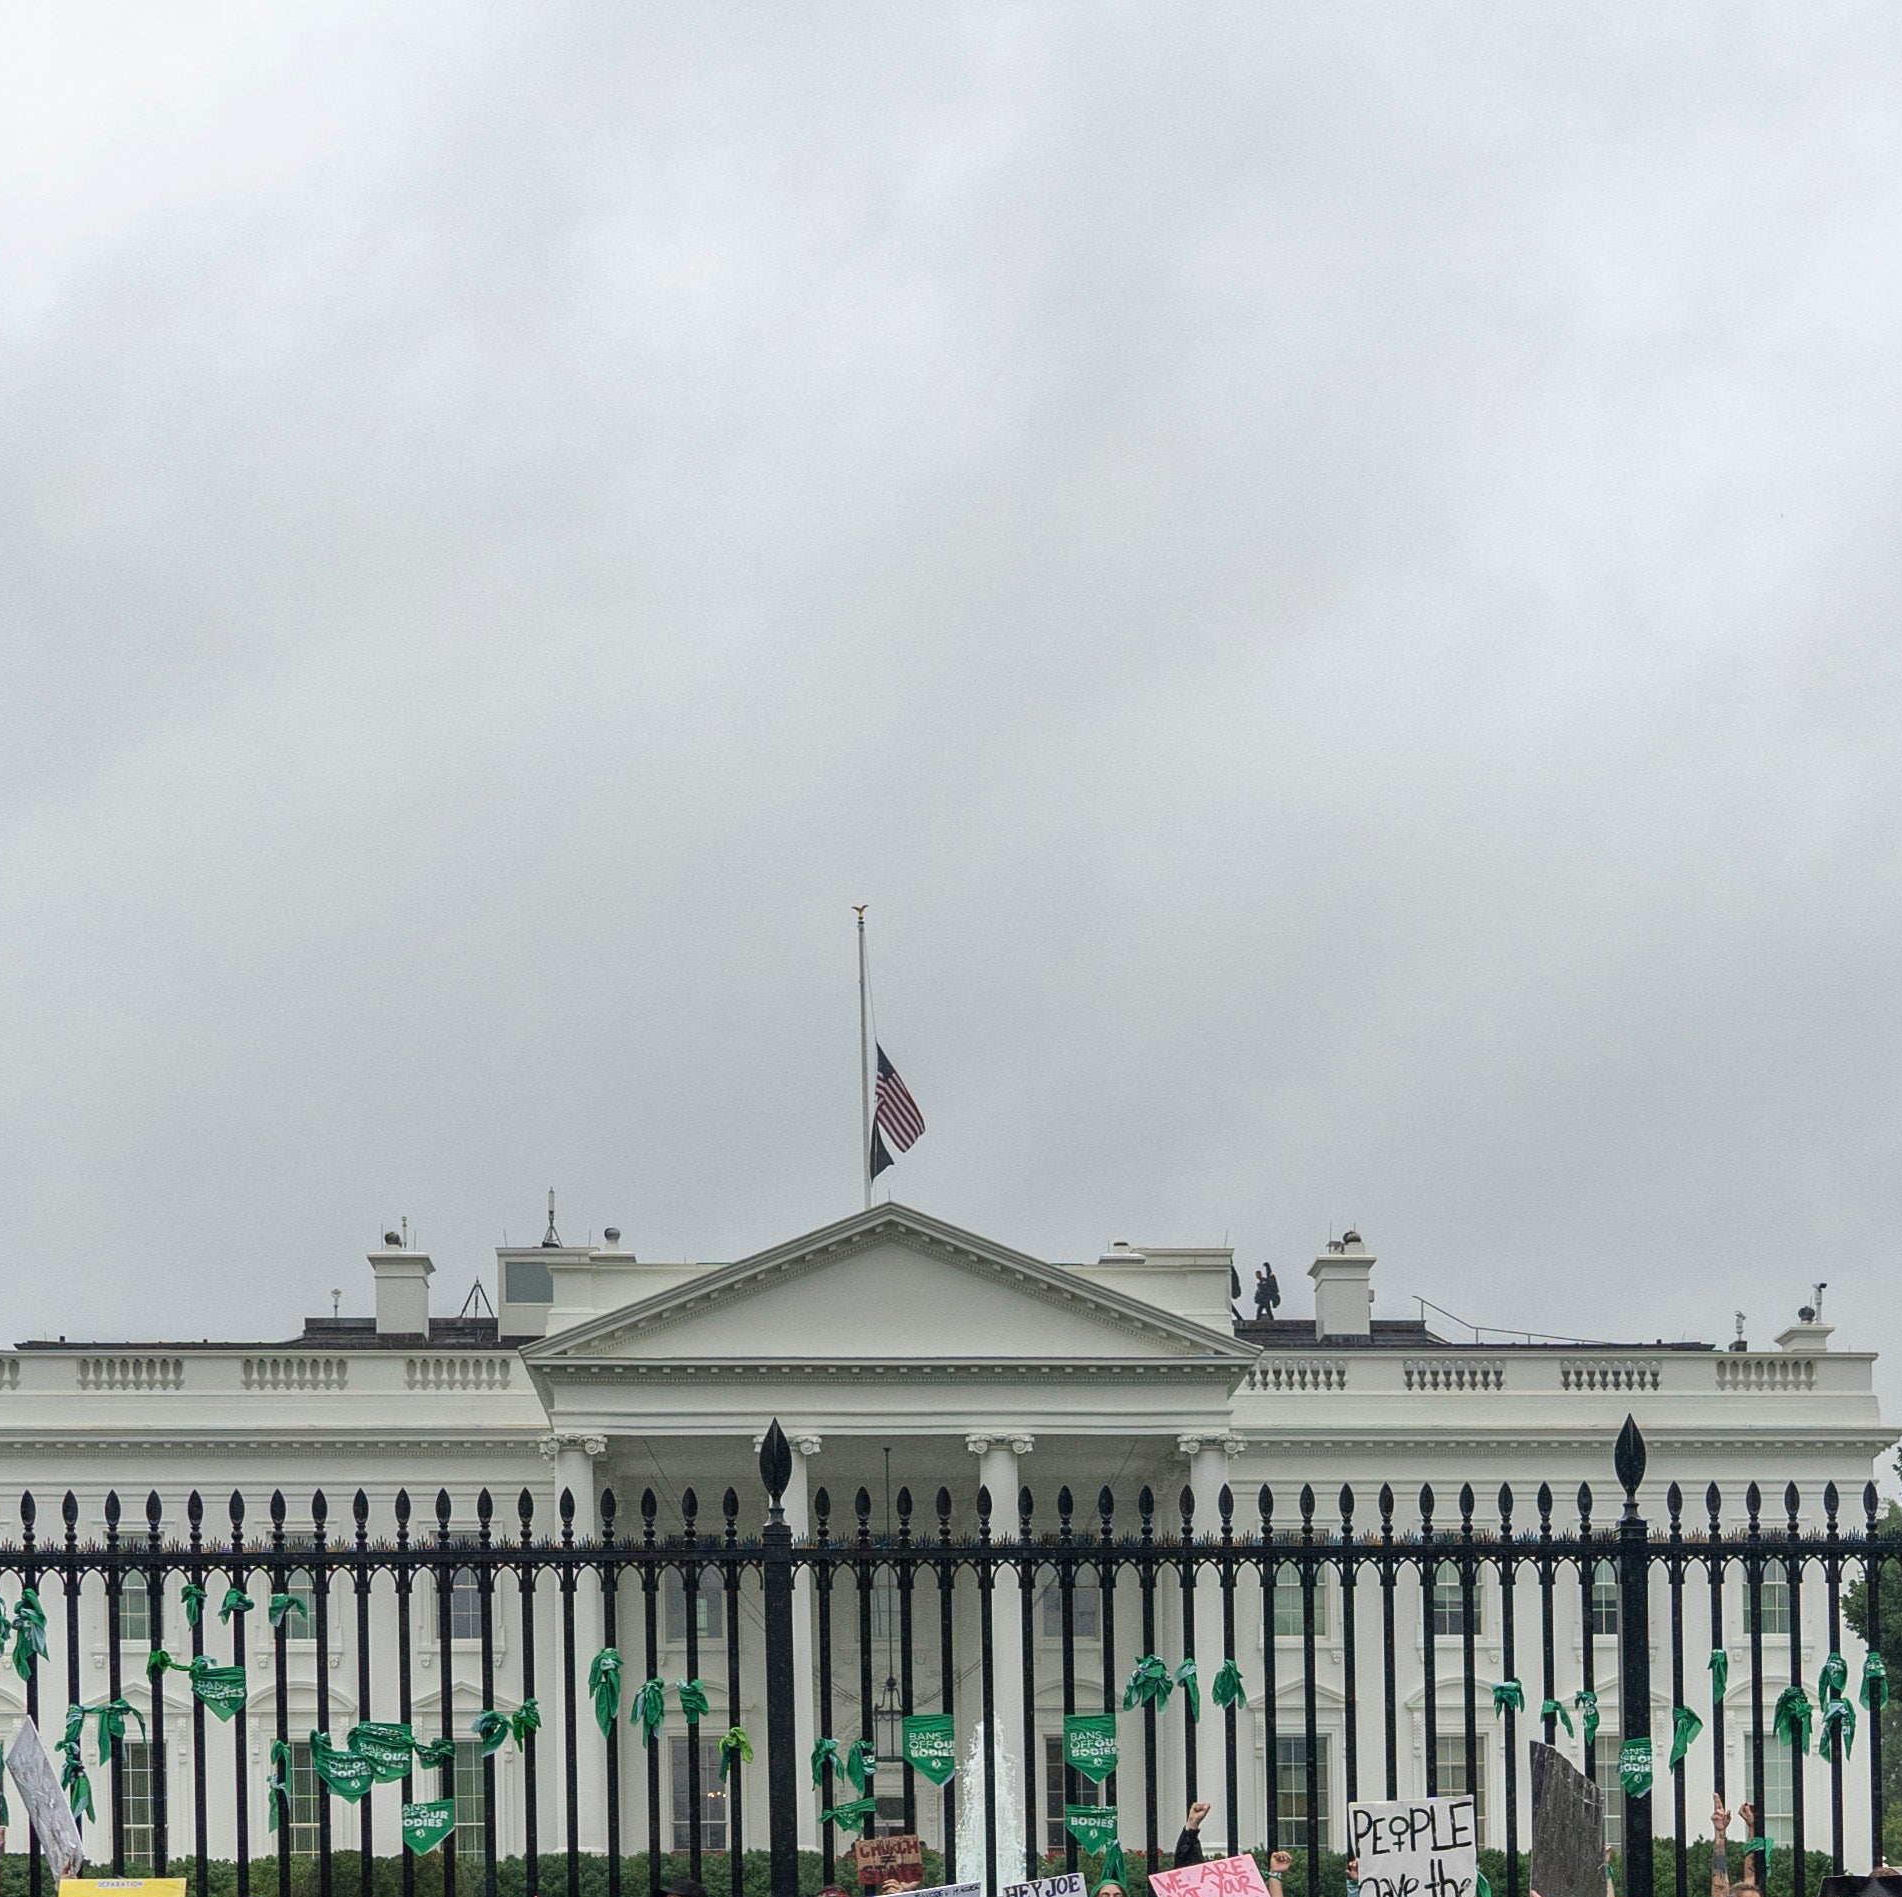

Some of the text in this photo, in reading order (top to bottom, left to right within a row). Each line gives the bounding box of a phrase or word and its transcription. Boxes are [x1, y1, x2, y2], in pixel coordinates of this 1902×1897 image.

[909, 1732, 942, 1741] BANS
[1070, 1731, 1102, 1741] BANS
[909, 1741, 933, 1749] OFF
[1070, 1740, 1093, 1749] OFF
[383, 1752, 410, 1761] OUR
[420, 1811, 449, 1820] OUR
[1070, 1817, 1115, 1827] BODIES
[860, 1839, 920, 1859] CHURCH
[861, 1863, 923, 1883] STATE
[1153, 1858, 1248, 1894] WE ARE
[1047, 1874, 1081, 1896] JOE
